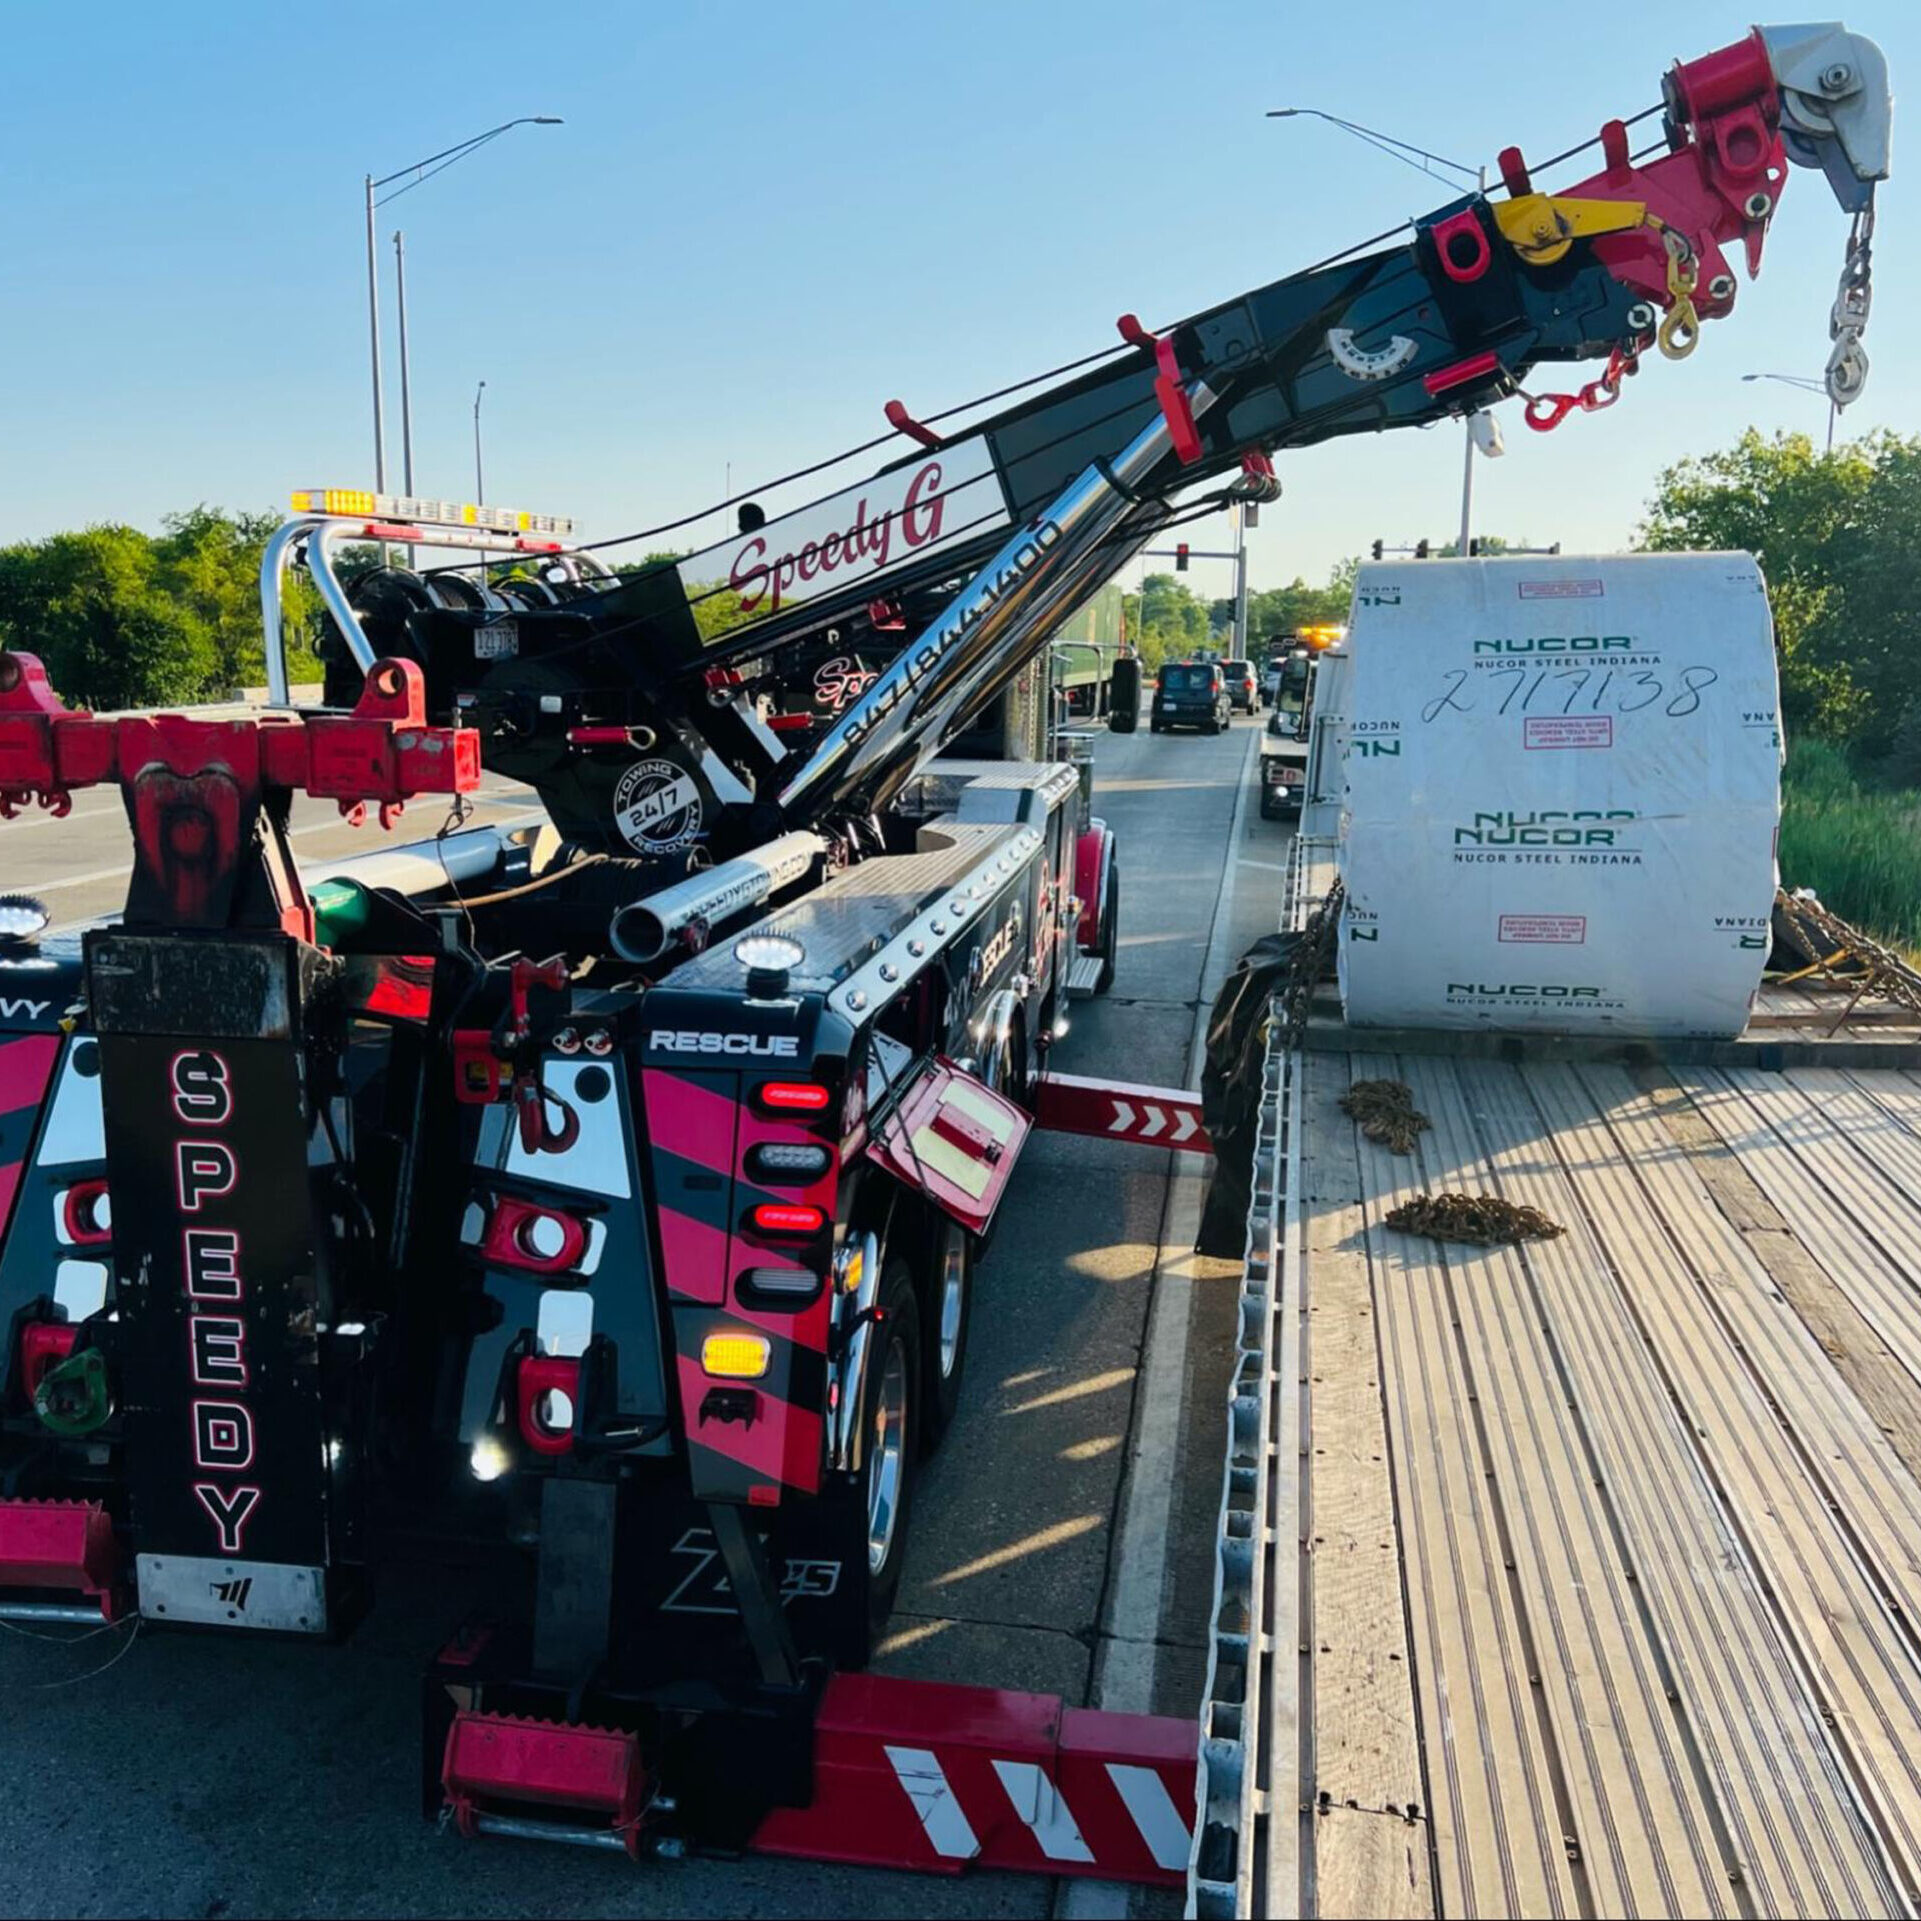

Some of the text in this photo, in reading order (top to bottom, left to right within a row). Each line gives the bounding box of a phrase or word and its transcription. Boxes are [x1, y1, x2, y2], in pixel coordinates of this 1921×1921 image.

[730, 462, 946, 616] Speedy G
[1474, 637, 1631, 653] NUCOR
[1474, 656, 1662, 669] NUCOR STEEL INDIANA
[618, 763, 673, 802] TOWING
[630, 787, 678, 827] 24/7
[633, 804, 699, 854] RECOVERY
[1455, 828, 1614, 845] NUCOR
[1454, 853, 1642, 864] NUCOR STEEL INDIANA
[1447, 984, 1600, 997] NUCOR
[1557, 1000, 1624, 1008] INDIANA
[650, 1030, 799, 1057] RESCUE
[172, 1050, 260, 1553] SPEEDY
